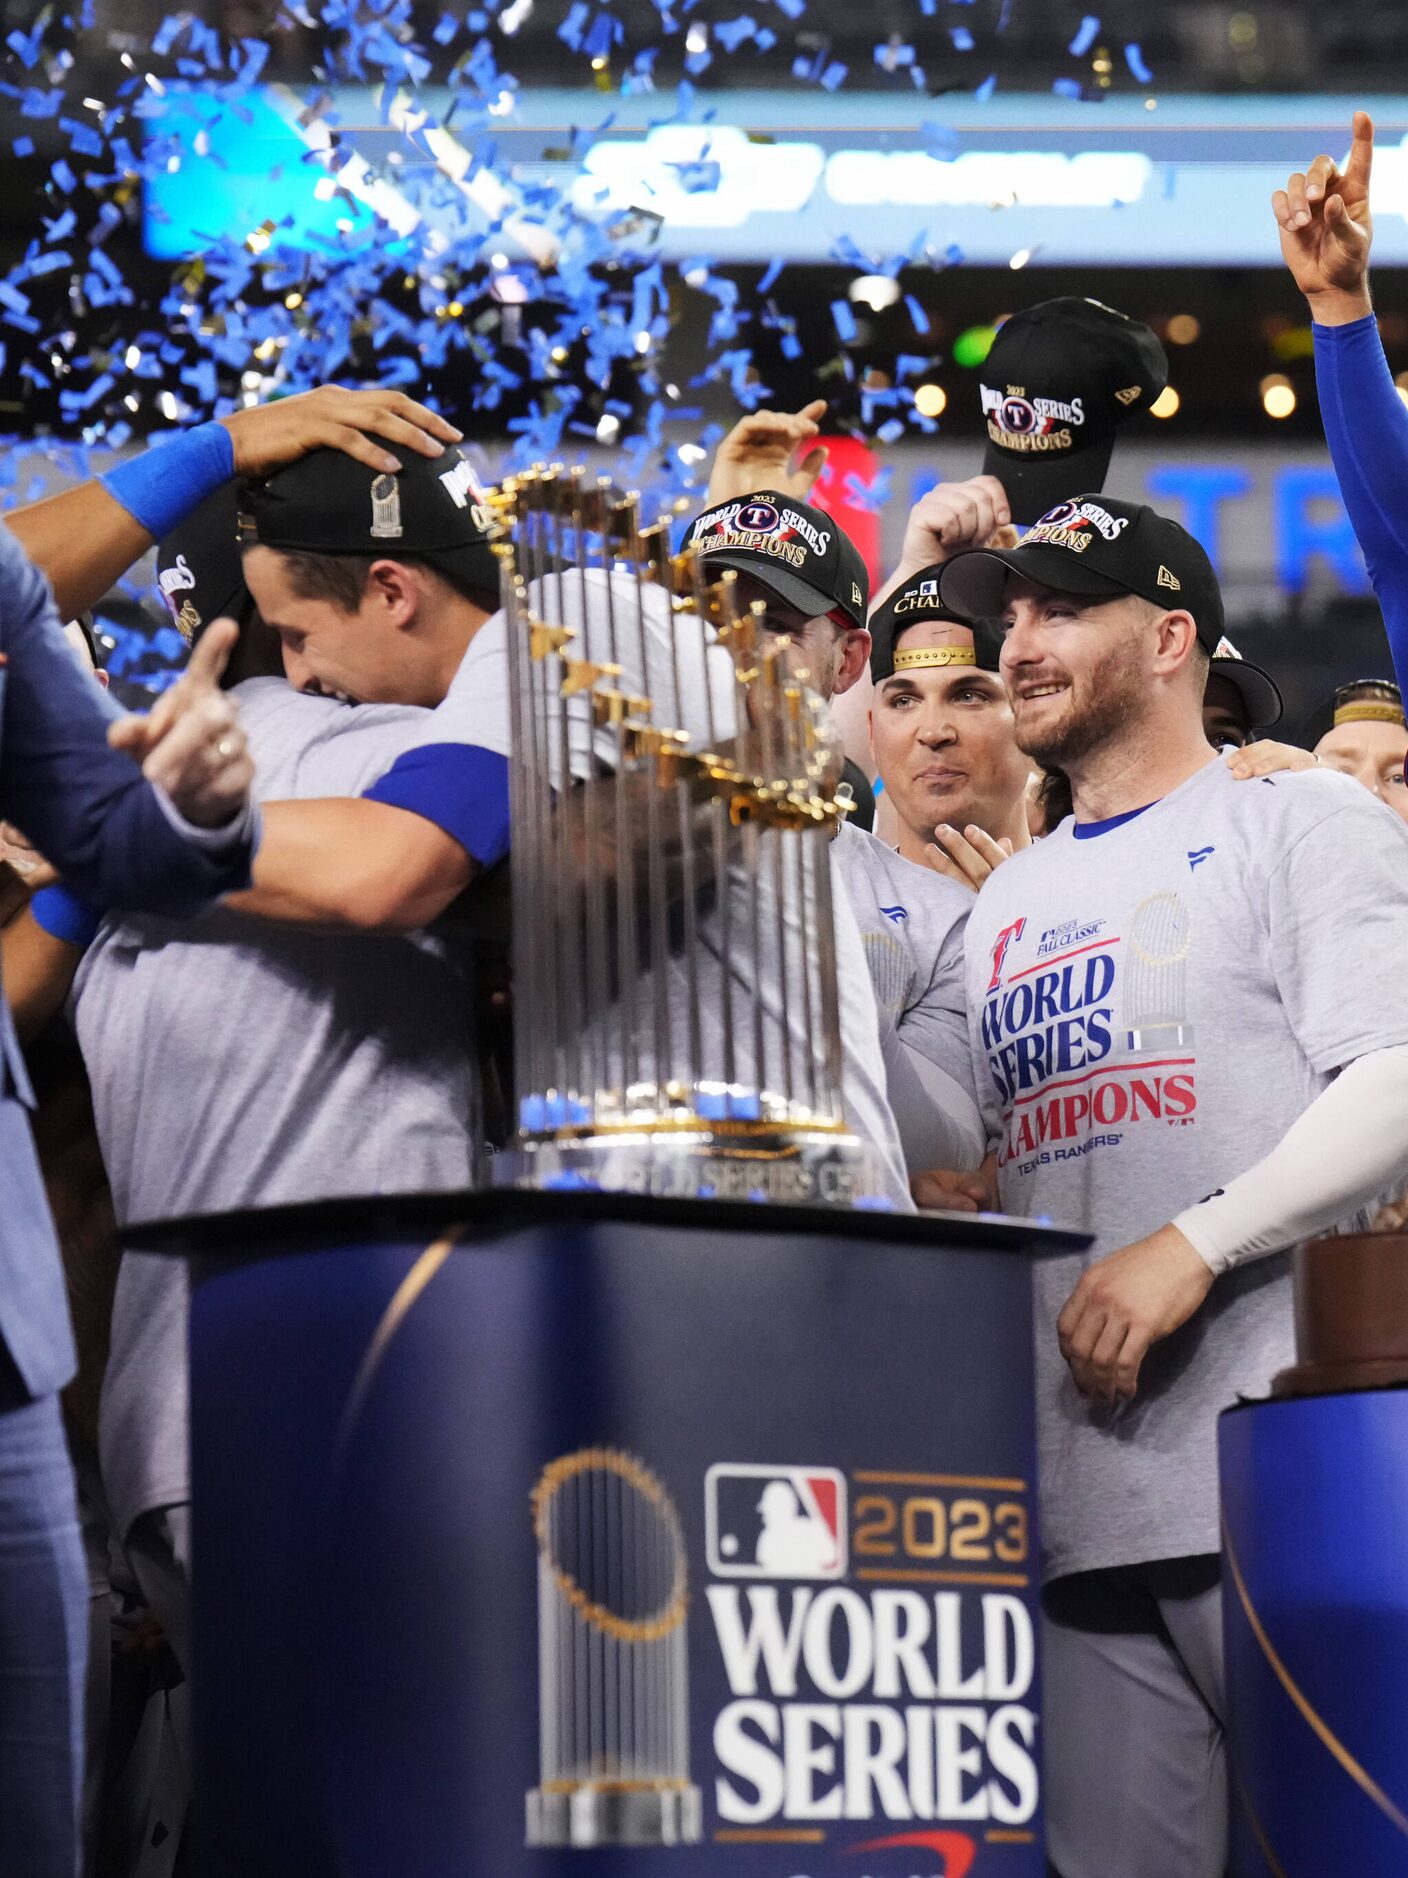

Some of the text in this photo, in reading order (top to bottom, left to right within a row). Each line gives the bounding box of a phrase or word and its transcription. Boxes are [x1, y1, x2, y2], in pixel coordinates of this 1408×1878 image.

[1033, 397, 1085, 426] SERIES
[751, 495, 776, 503] 2023
[692, 503, 741, 541] WORLD
[780, 508, 831, 557] SERIES
[1018, 525, 1093, 553] MPIONS
[1077, 502, 1130, 541] SERIES
[699, 531, 808, 567] CHAMPIONS
[893, 594, 943, 614] CHA
[1037, 922, 1103, 956] FALL CLASSIC
[982, 954, 1116, 1050] WORLD
[988, 1008, 1114, 1107] SERIES
[999, 1075, 1196, 1167] AMPIONS
[1055, 1133, 1121, 1162] RANERS
[853, 1494, 1029, 1563] 2023
[705, 1585, 1035, 1701] WORLD
[712, 1698, 1040, 1825] SERIES
